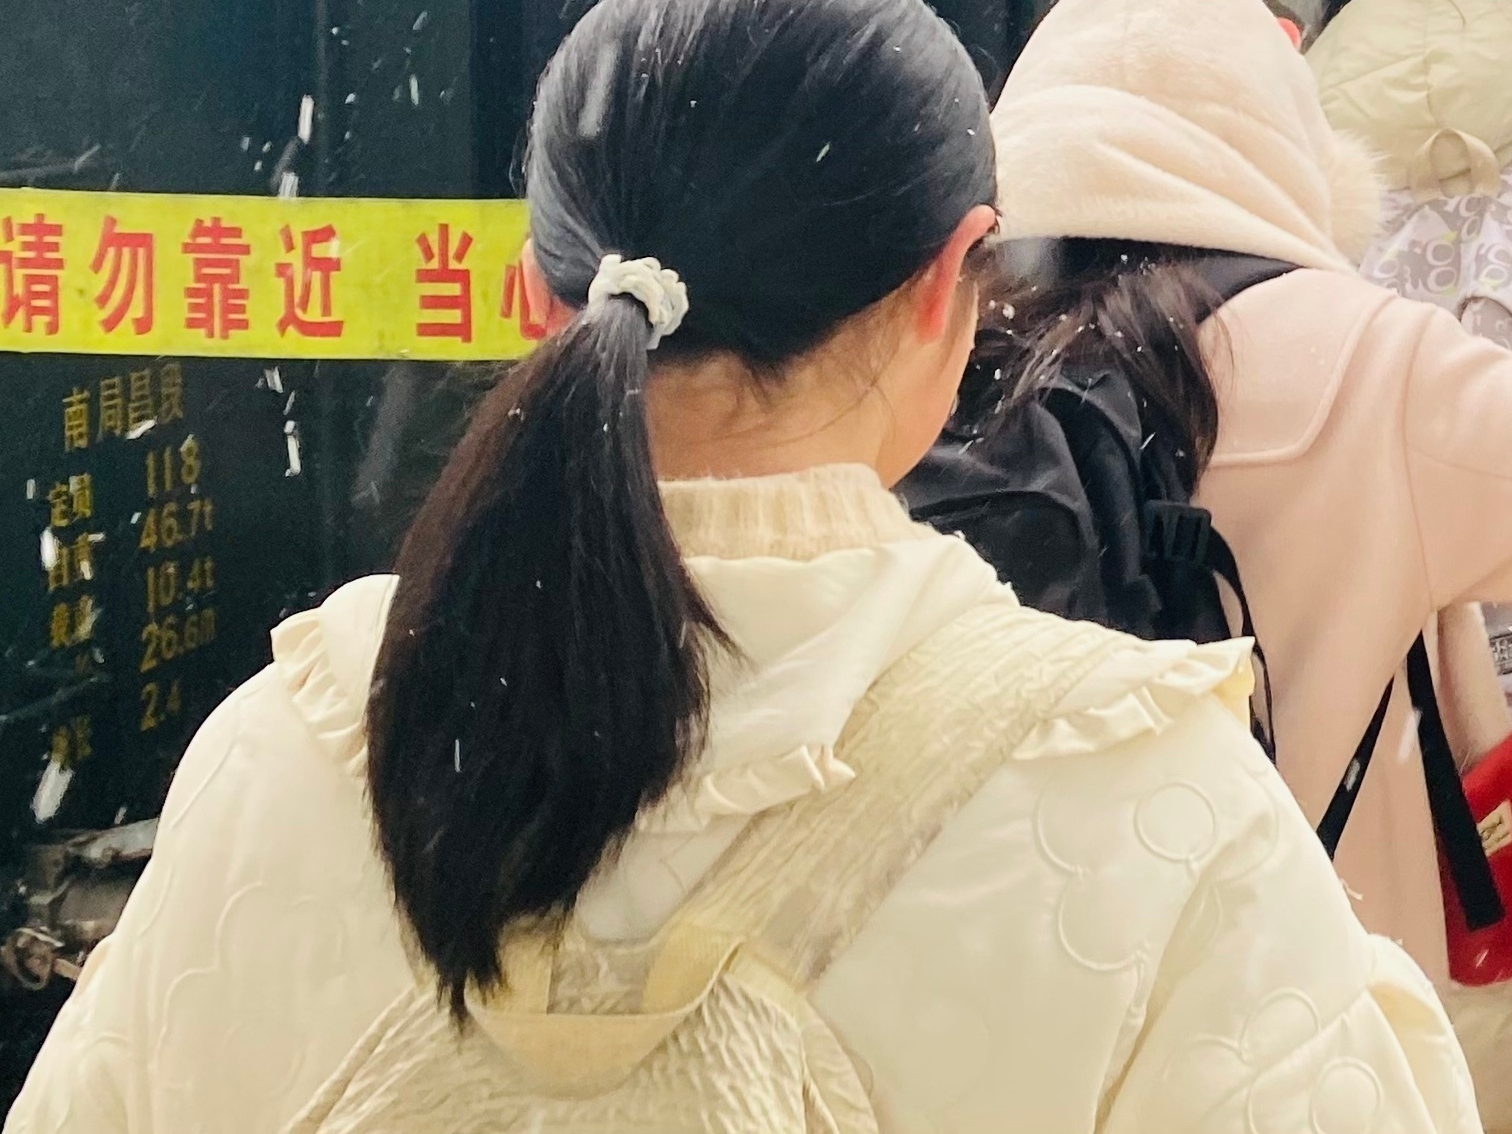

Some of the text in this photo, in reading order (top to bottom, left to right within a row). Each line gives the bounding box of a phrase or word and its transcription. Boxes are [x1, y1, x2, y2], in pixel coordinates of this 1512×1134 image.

[0, 213, 345, 340] 请勿靠近
[146, 434, 199, 498] 118
